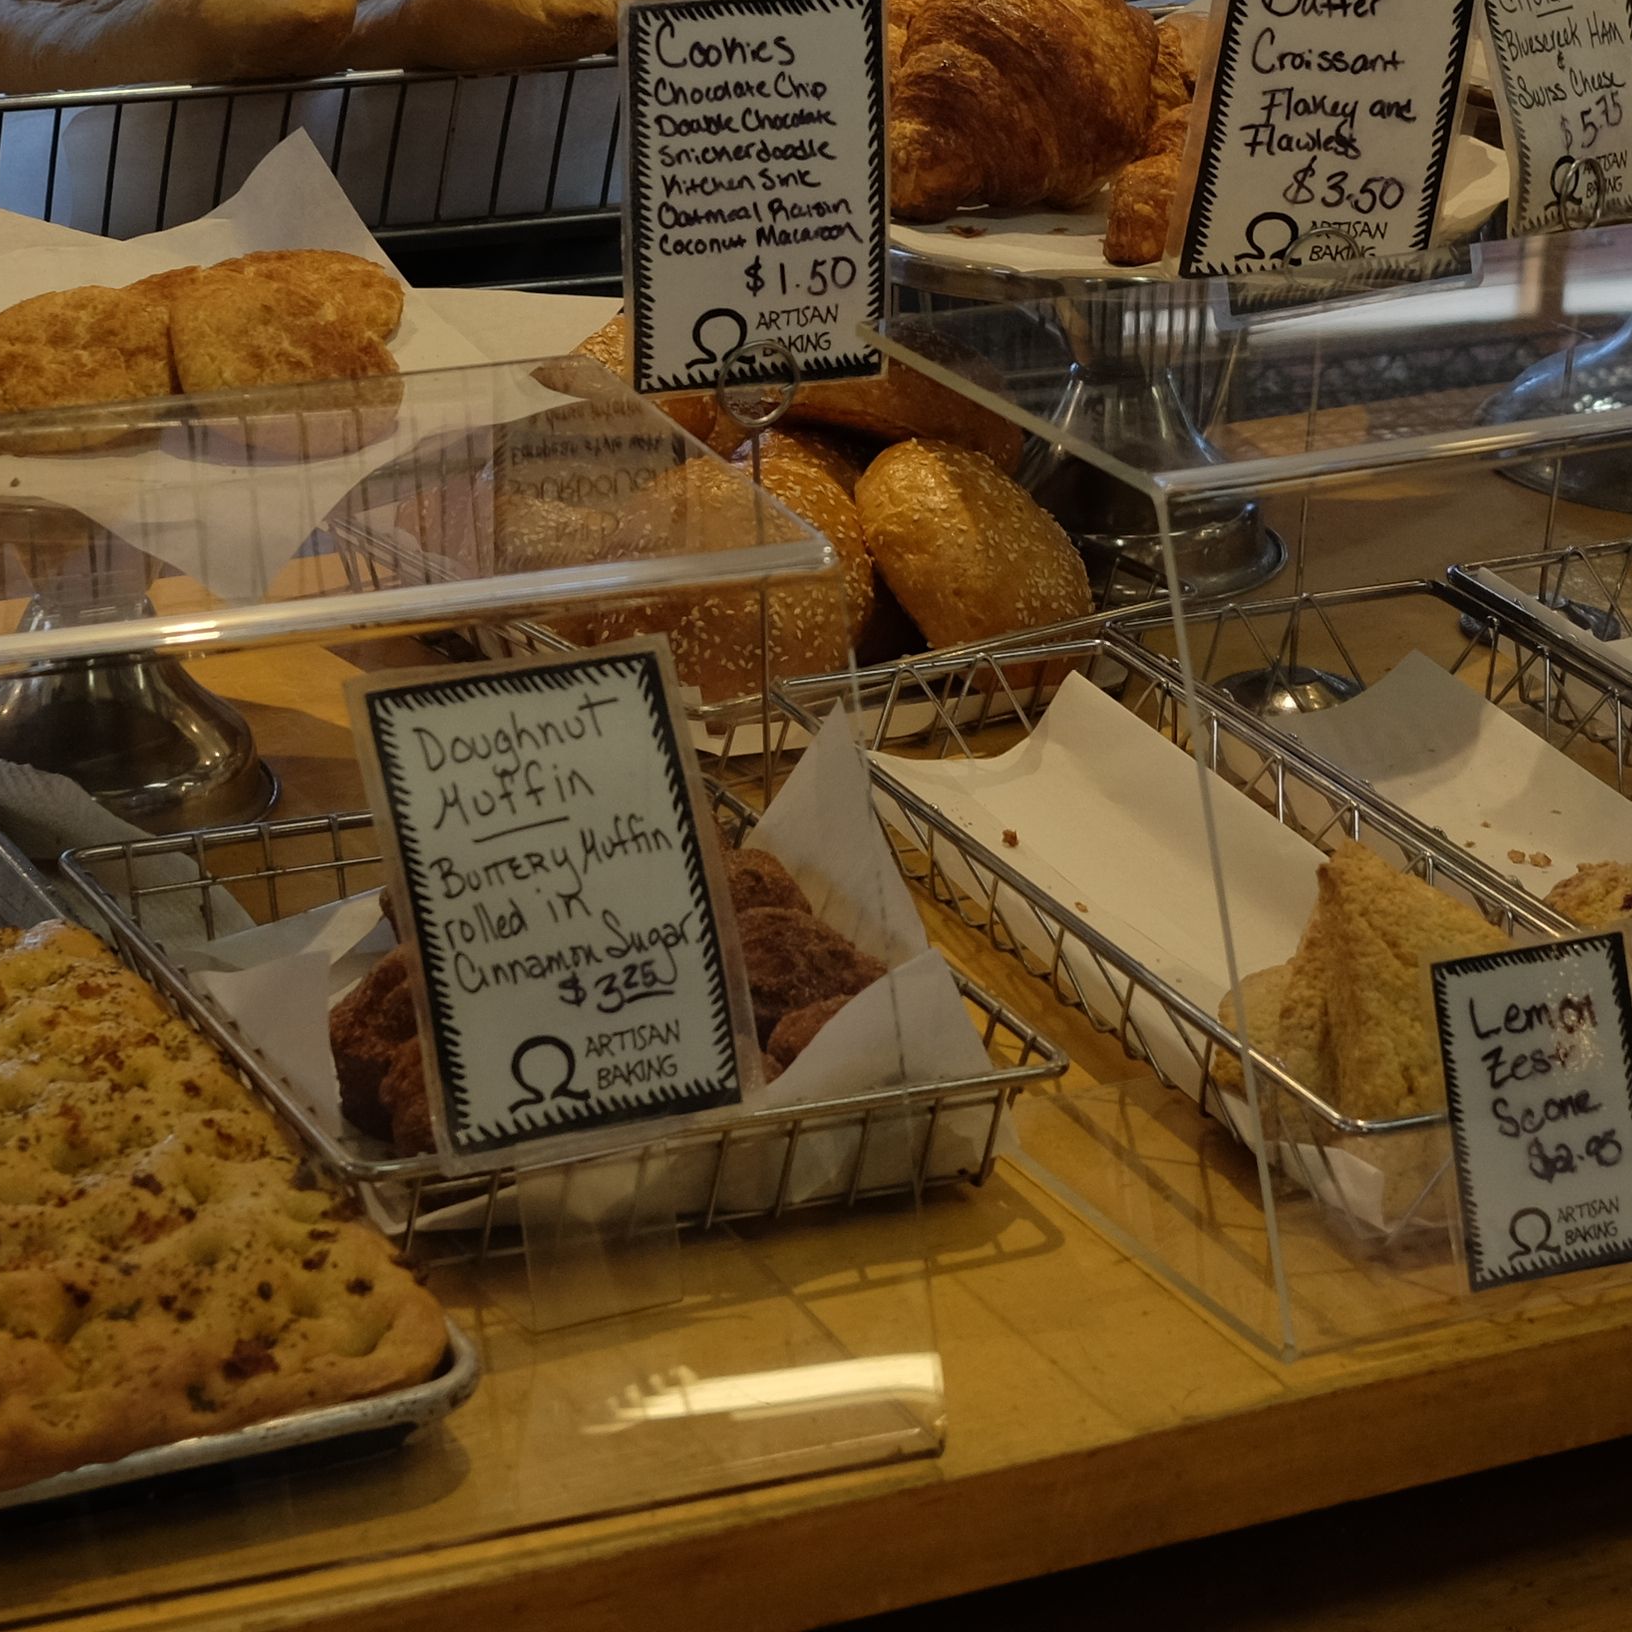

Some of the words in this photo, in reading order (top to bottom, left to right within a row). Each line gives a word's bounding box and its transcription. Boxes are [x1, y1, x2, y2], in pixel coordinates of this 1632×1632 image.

[655, 21, 795, 68] Cookies
[1252, 28, 1405, 74] Croissant
[654, 77, 771, 106] Chocolate
[774, 72, 827, 100] Chip
[1262, 87, 1358, 121] Flakey
[1369, 100, 1416, 121] and
[1517, 76, 1567, 110] Swiss
[1569, 67, 1626, 92] Cheese
[1283, 156, 1404, 213] $3.50
[658, 203, 759, 229] Oatmeal
[659, 234, 746, 256] Coconut
[757, 226, 863, 247] Macaroon
[757, 304, 838, 330] ARTISAN
[412, 693, 619, 776] Doughnut
[435, 761, 595, 831] Muffin
[581, 814, 673, 875] Muffin
[445, 895, 528, 951] rolled
[547, 889, 592, 919] in
[453, 941, 602, 995] Cinnamon
[602, 910, 696, 983] Sugar
[1469, 993, 1598, 1039] Lemon
[585, 1020, 681, 1058] ARTISAN
[597, 1055, 679, 1090] BAKING
[1480, 1046, 1572, 1089] Zest
[1492, 1089, 1602, 1138] Scone
[1557, 1197, 1619, 1224] ARTISAN
[1565, 1220, 1618, 1246] BAKING
